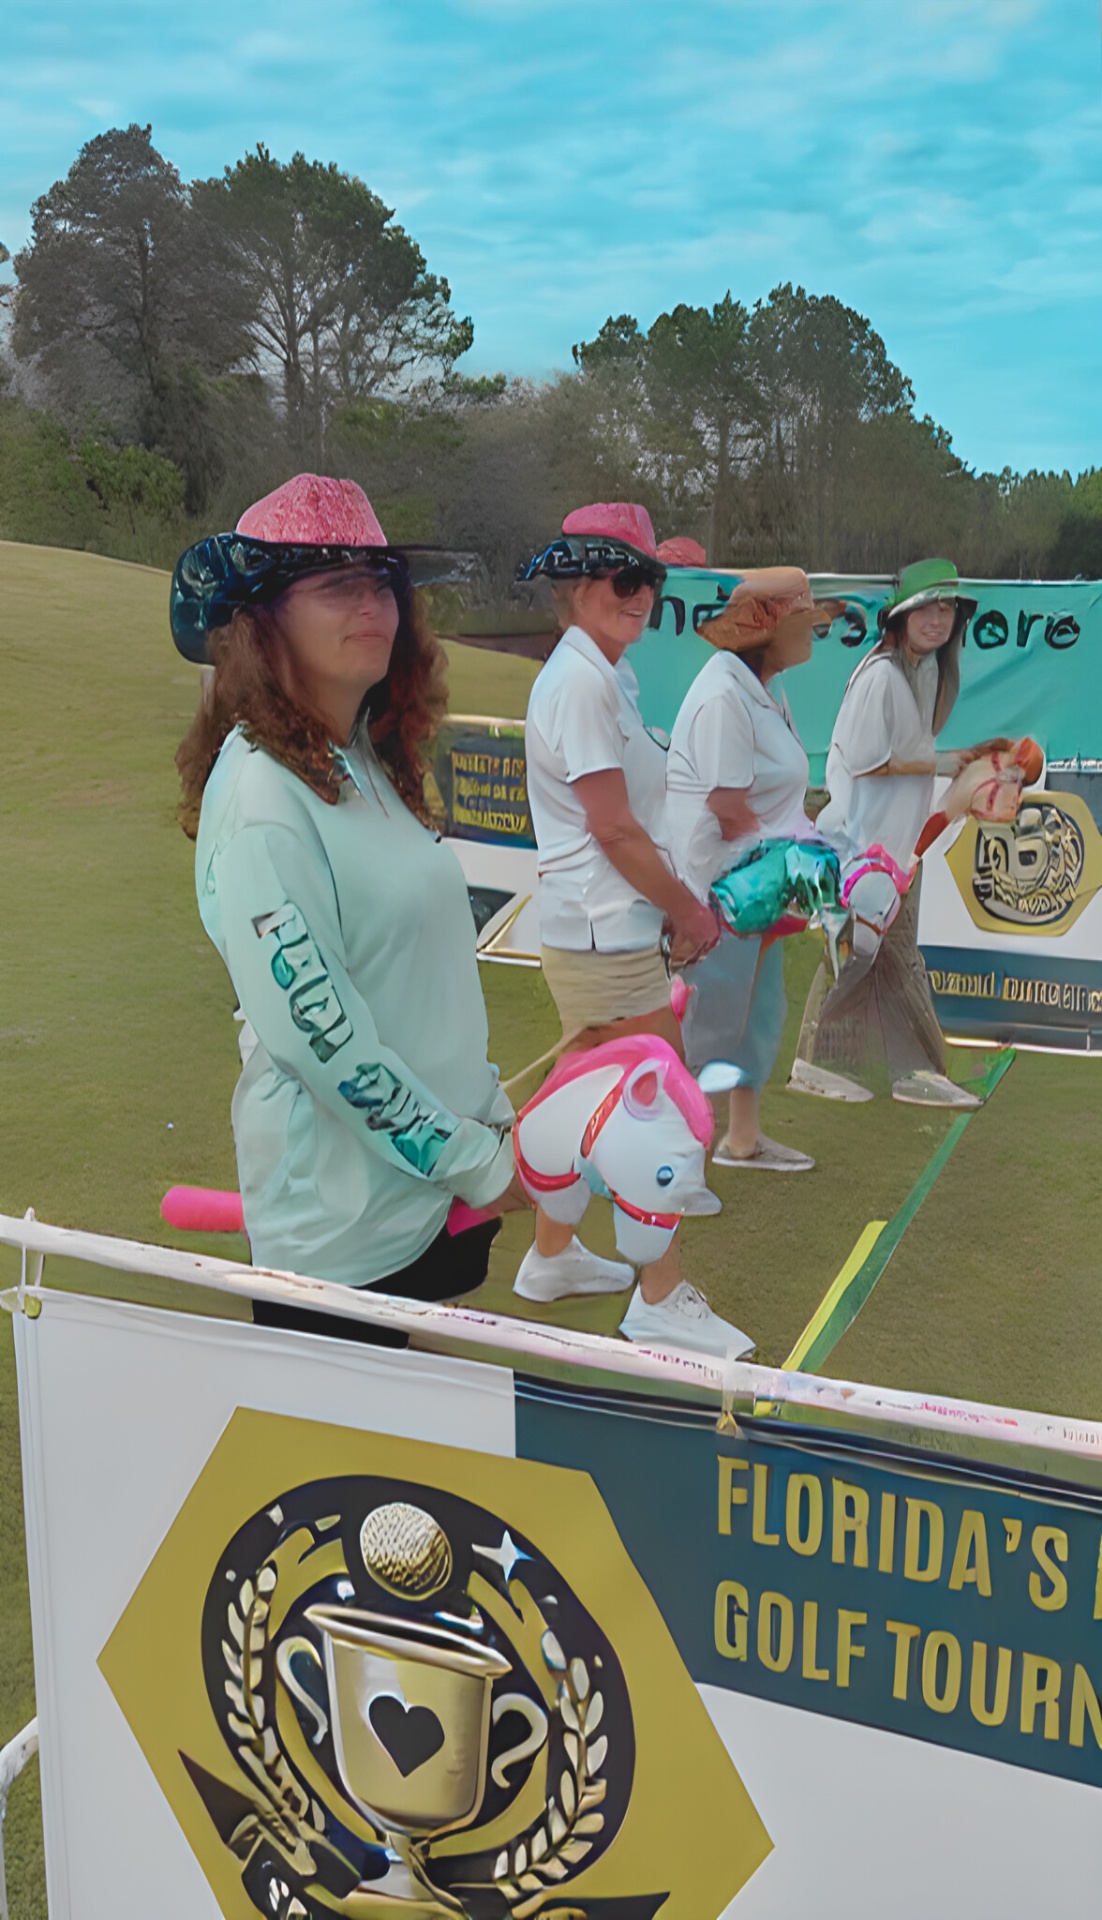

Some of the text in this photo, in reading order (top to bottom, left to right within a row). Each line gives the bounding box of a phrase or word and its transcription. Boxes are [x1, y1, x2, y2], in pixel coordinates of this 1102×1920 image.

[962, 609, 1081, 650] ore
[717, 1454, 1069, 1612] FLORIDA'S
[713, 1579, 1102, 1751] GOLF TOURN
